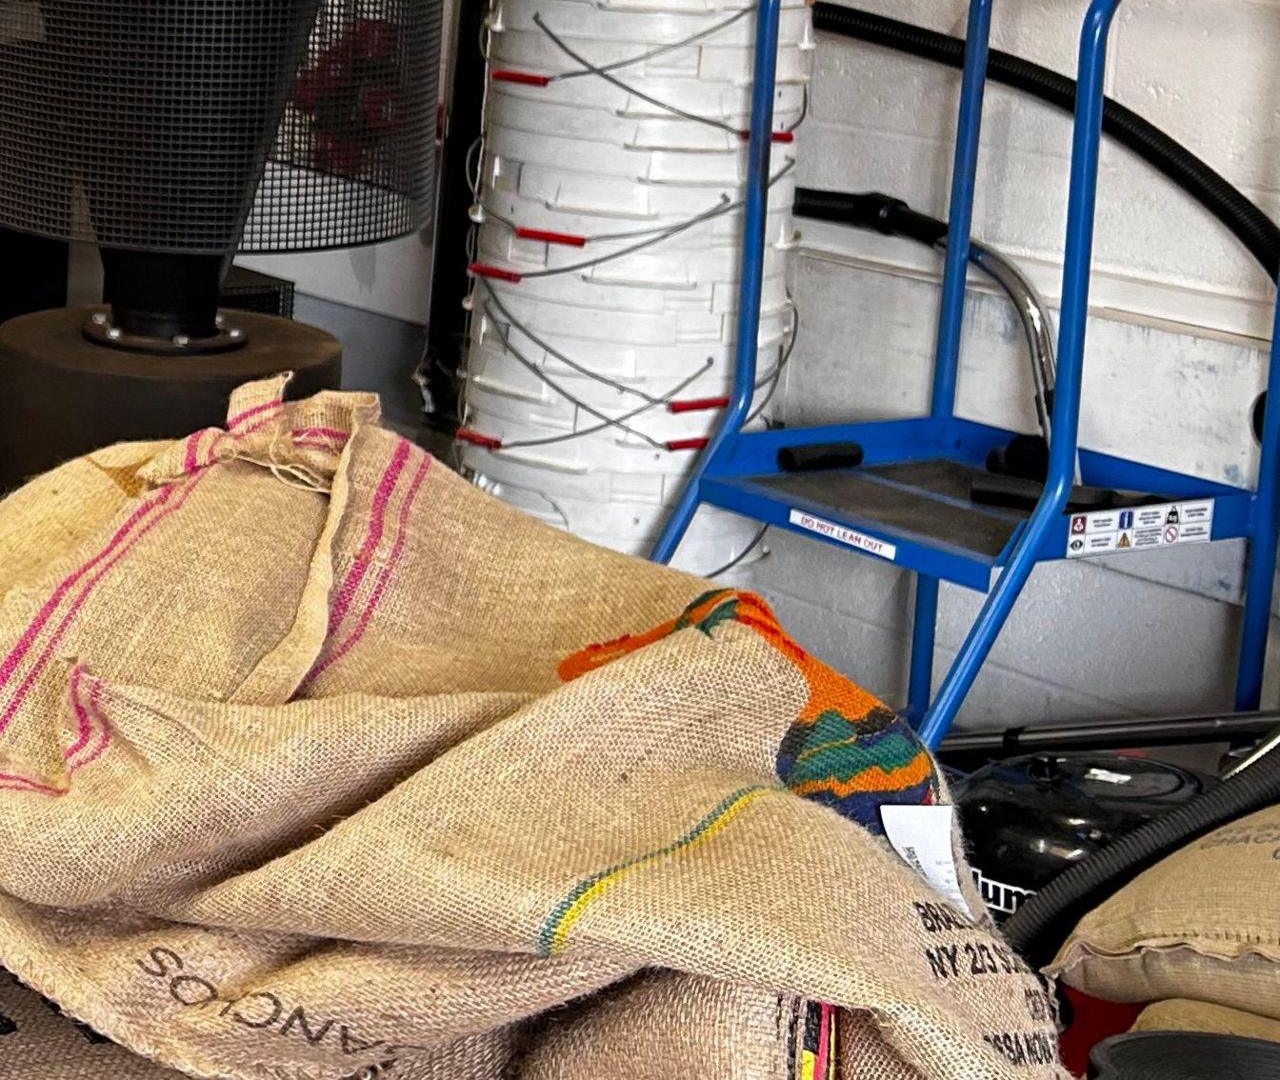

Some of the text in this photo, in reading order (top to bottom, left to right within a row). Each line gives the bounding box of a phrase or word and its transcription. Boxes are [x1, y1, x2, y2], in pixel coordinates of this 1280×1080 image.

[801, 516, 883, 552] DO NOT LEAN OUT
[926, 944, 959, 979] NY
